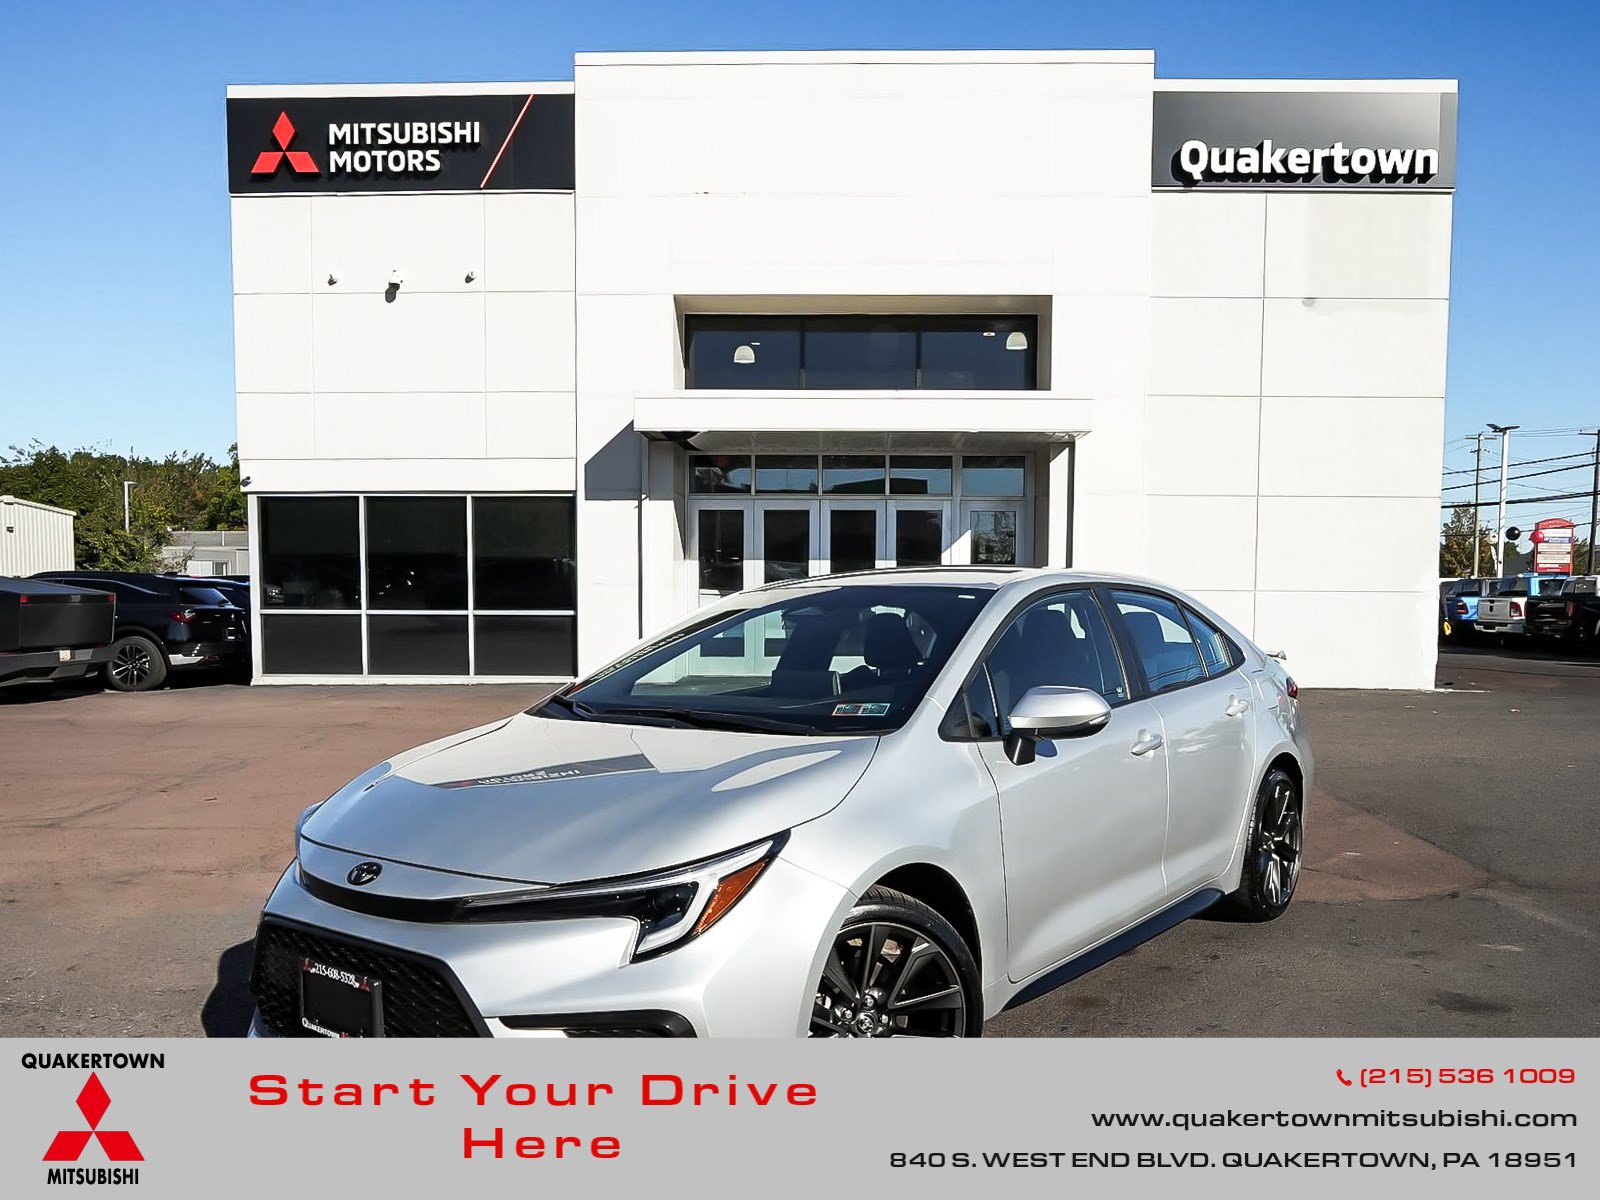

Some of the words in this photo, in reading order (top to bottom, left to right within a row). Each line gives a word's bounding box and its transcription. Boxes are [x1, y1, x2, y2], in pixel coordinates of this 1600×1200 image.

[329, 121, 480, 145] MITSUBISHI
[329, 149, 441, 173] MOTORS
[1180, 139, 1439, 181] Quakertown
